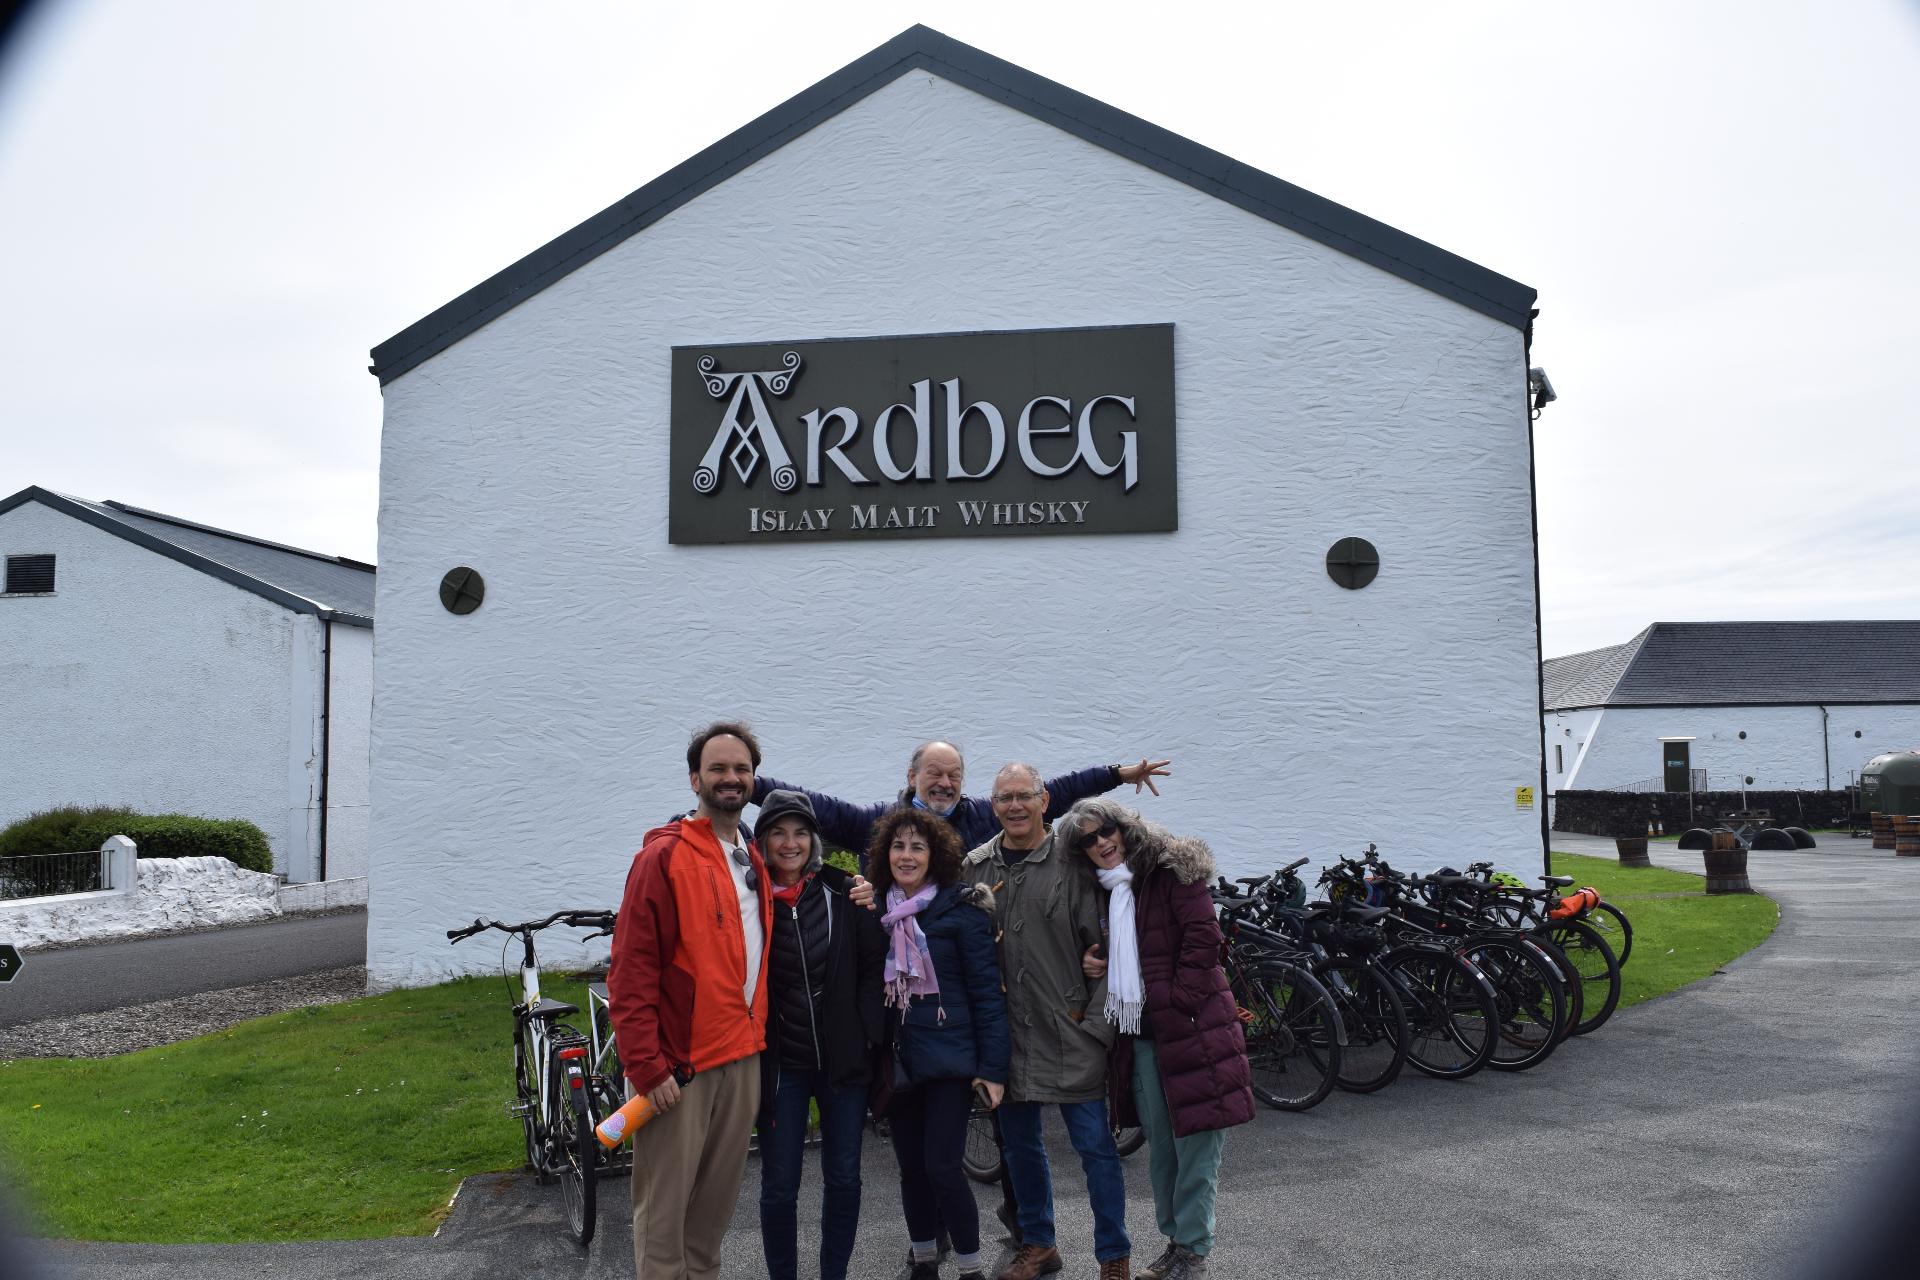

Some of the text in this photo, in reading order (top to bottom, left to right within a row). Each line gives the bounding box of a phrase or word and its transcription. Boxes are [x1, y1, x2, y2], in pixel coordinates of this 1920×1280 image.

[748, 500, 1091, 532] ISLAY MALT WHISKY
